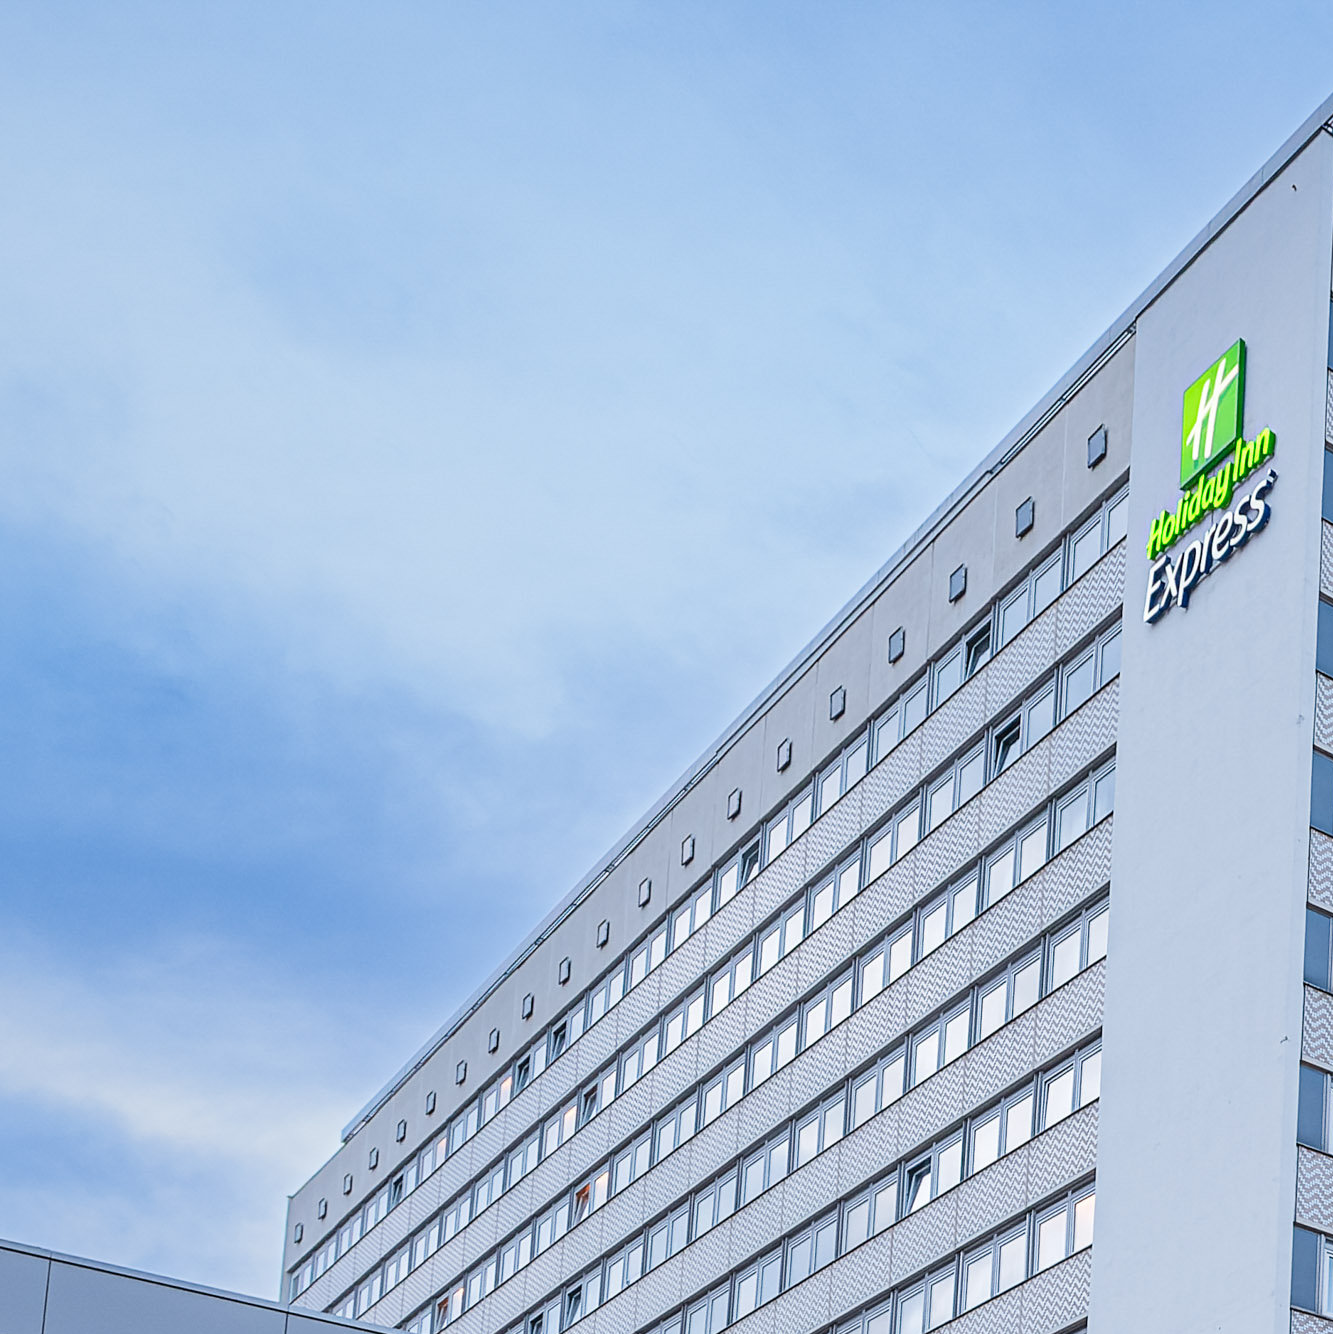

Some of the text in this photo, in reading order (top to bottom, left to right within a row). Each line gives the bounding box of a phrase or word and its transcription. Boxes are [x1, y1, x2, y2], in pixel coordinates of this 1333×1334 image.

[1144, 477, 1272, 625] Express
[1146, 426, 1276, 561] Holiday Inn
